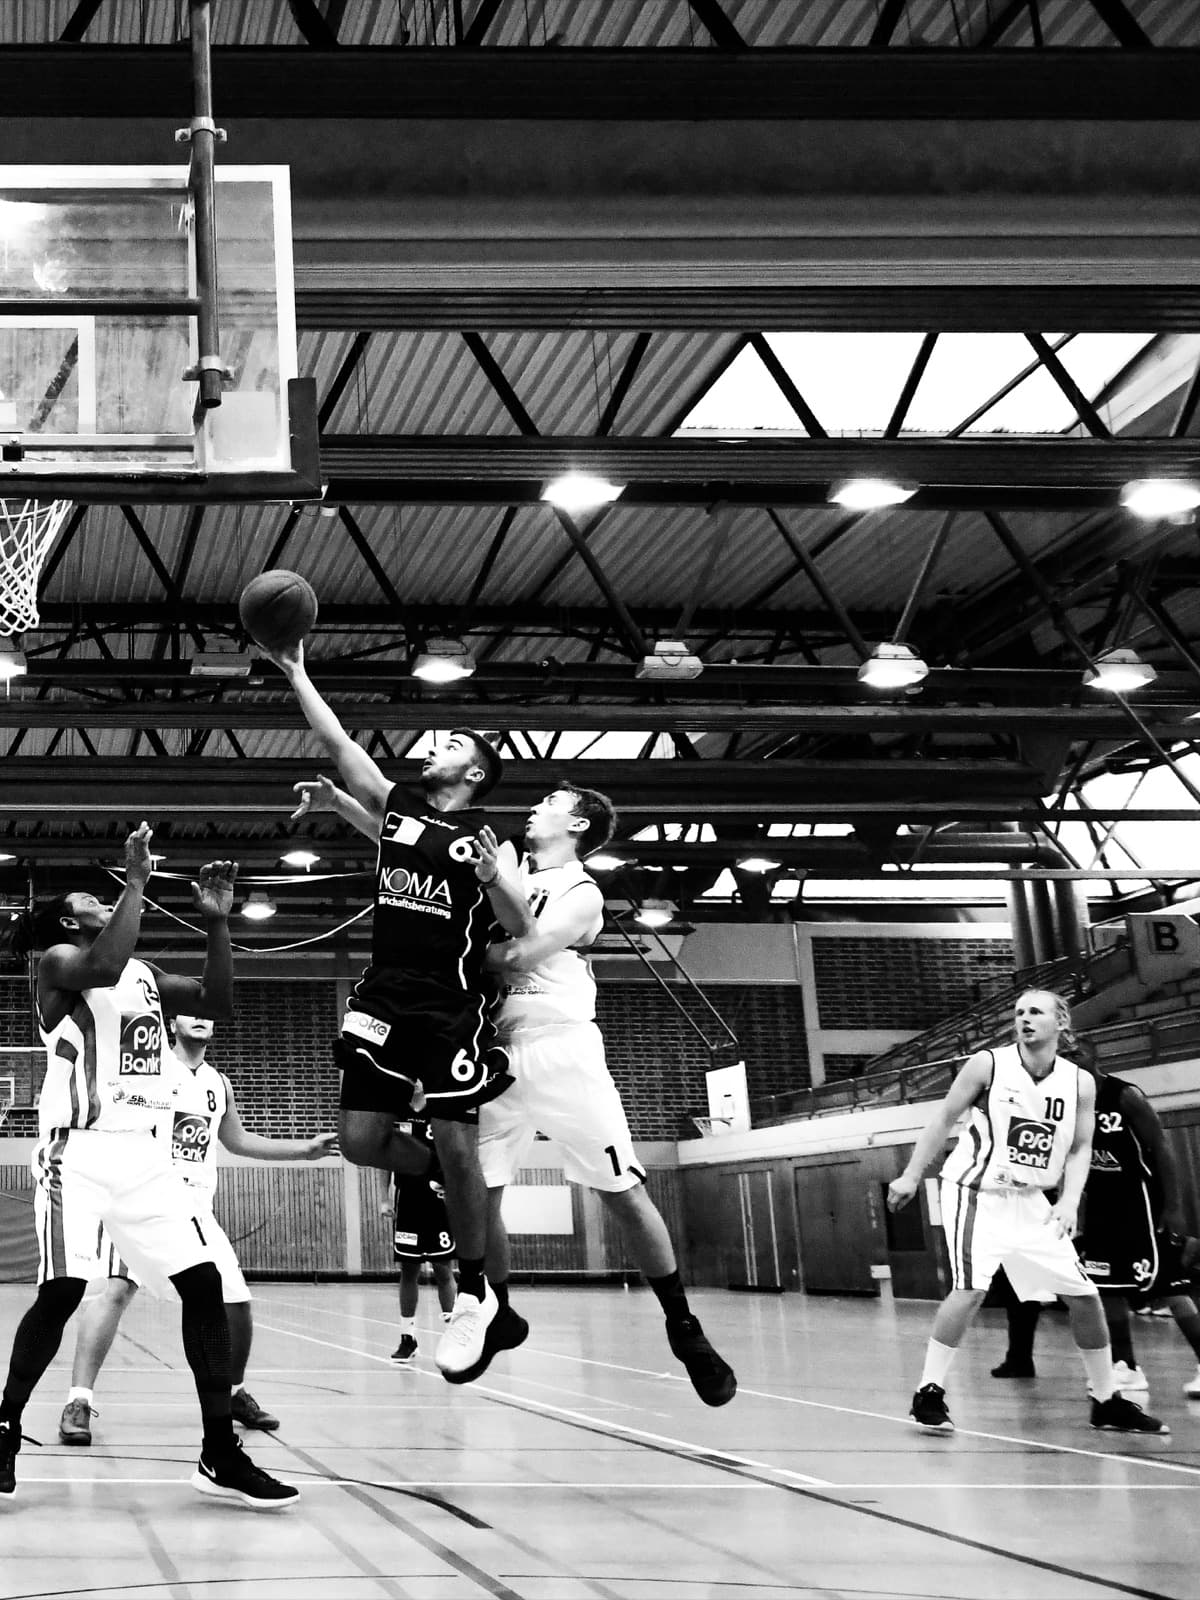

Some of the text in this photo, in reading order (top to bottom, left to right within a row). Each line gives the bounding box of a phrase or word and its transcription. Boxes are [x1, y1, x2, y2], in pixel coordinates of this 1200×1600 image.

[448, 836, 475, 862] 6
[379, 867, 452, 905] NOMA
[1152, 922, 1179, 951] B
[451, 1048, 475, 1082] 6
[207, 1090, 216, 1112] 8
[1045, 1096, 1065, 1122] 10
[1099, 1112, 1123, 1133] 32
[172, 1143, 205, 1162] Bank
[1008, 1146, 1049, 1168] Bank
[439, 1231, 451, 1248] 8
[1132, 1258, 1153, 1282] 32
